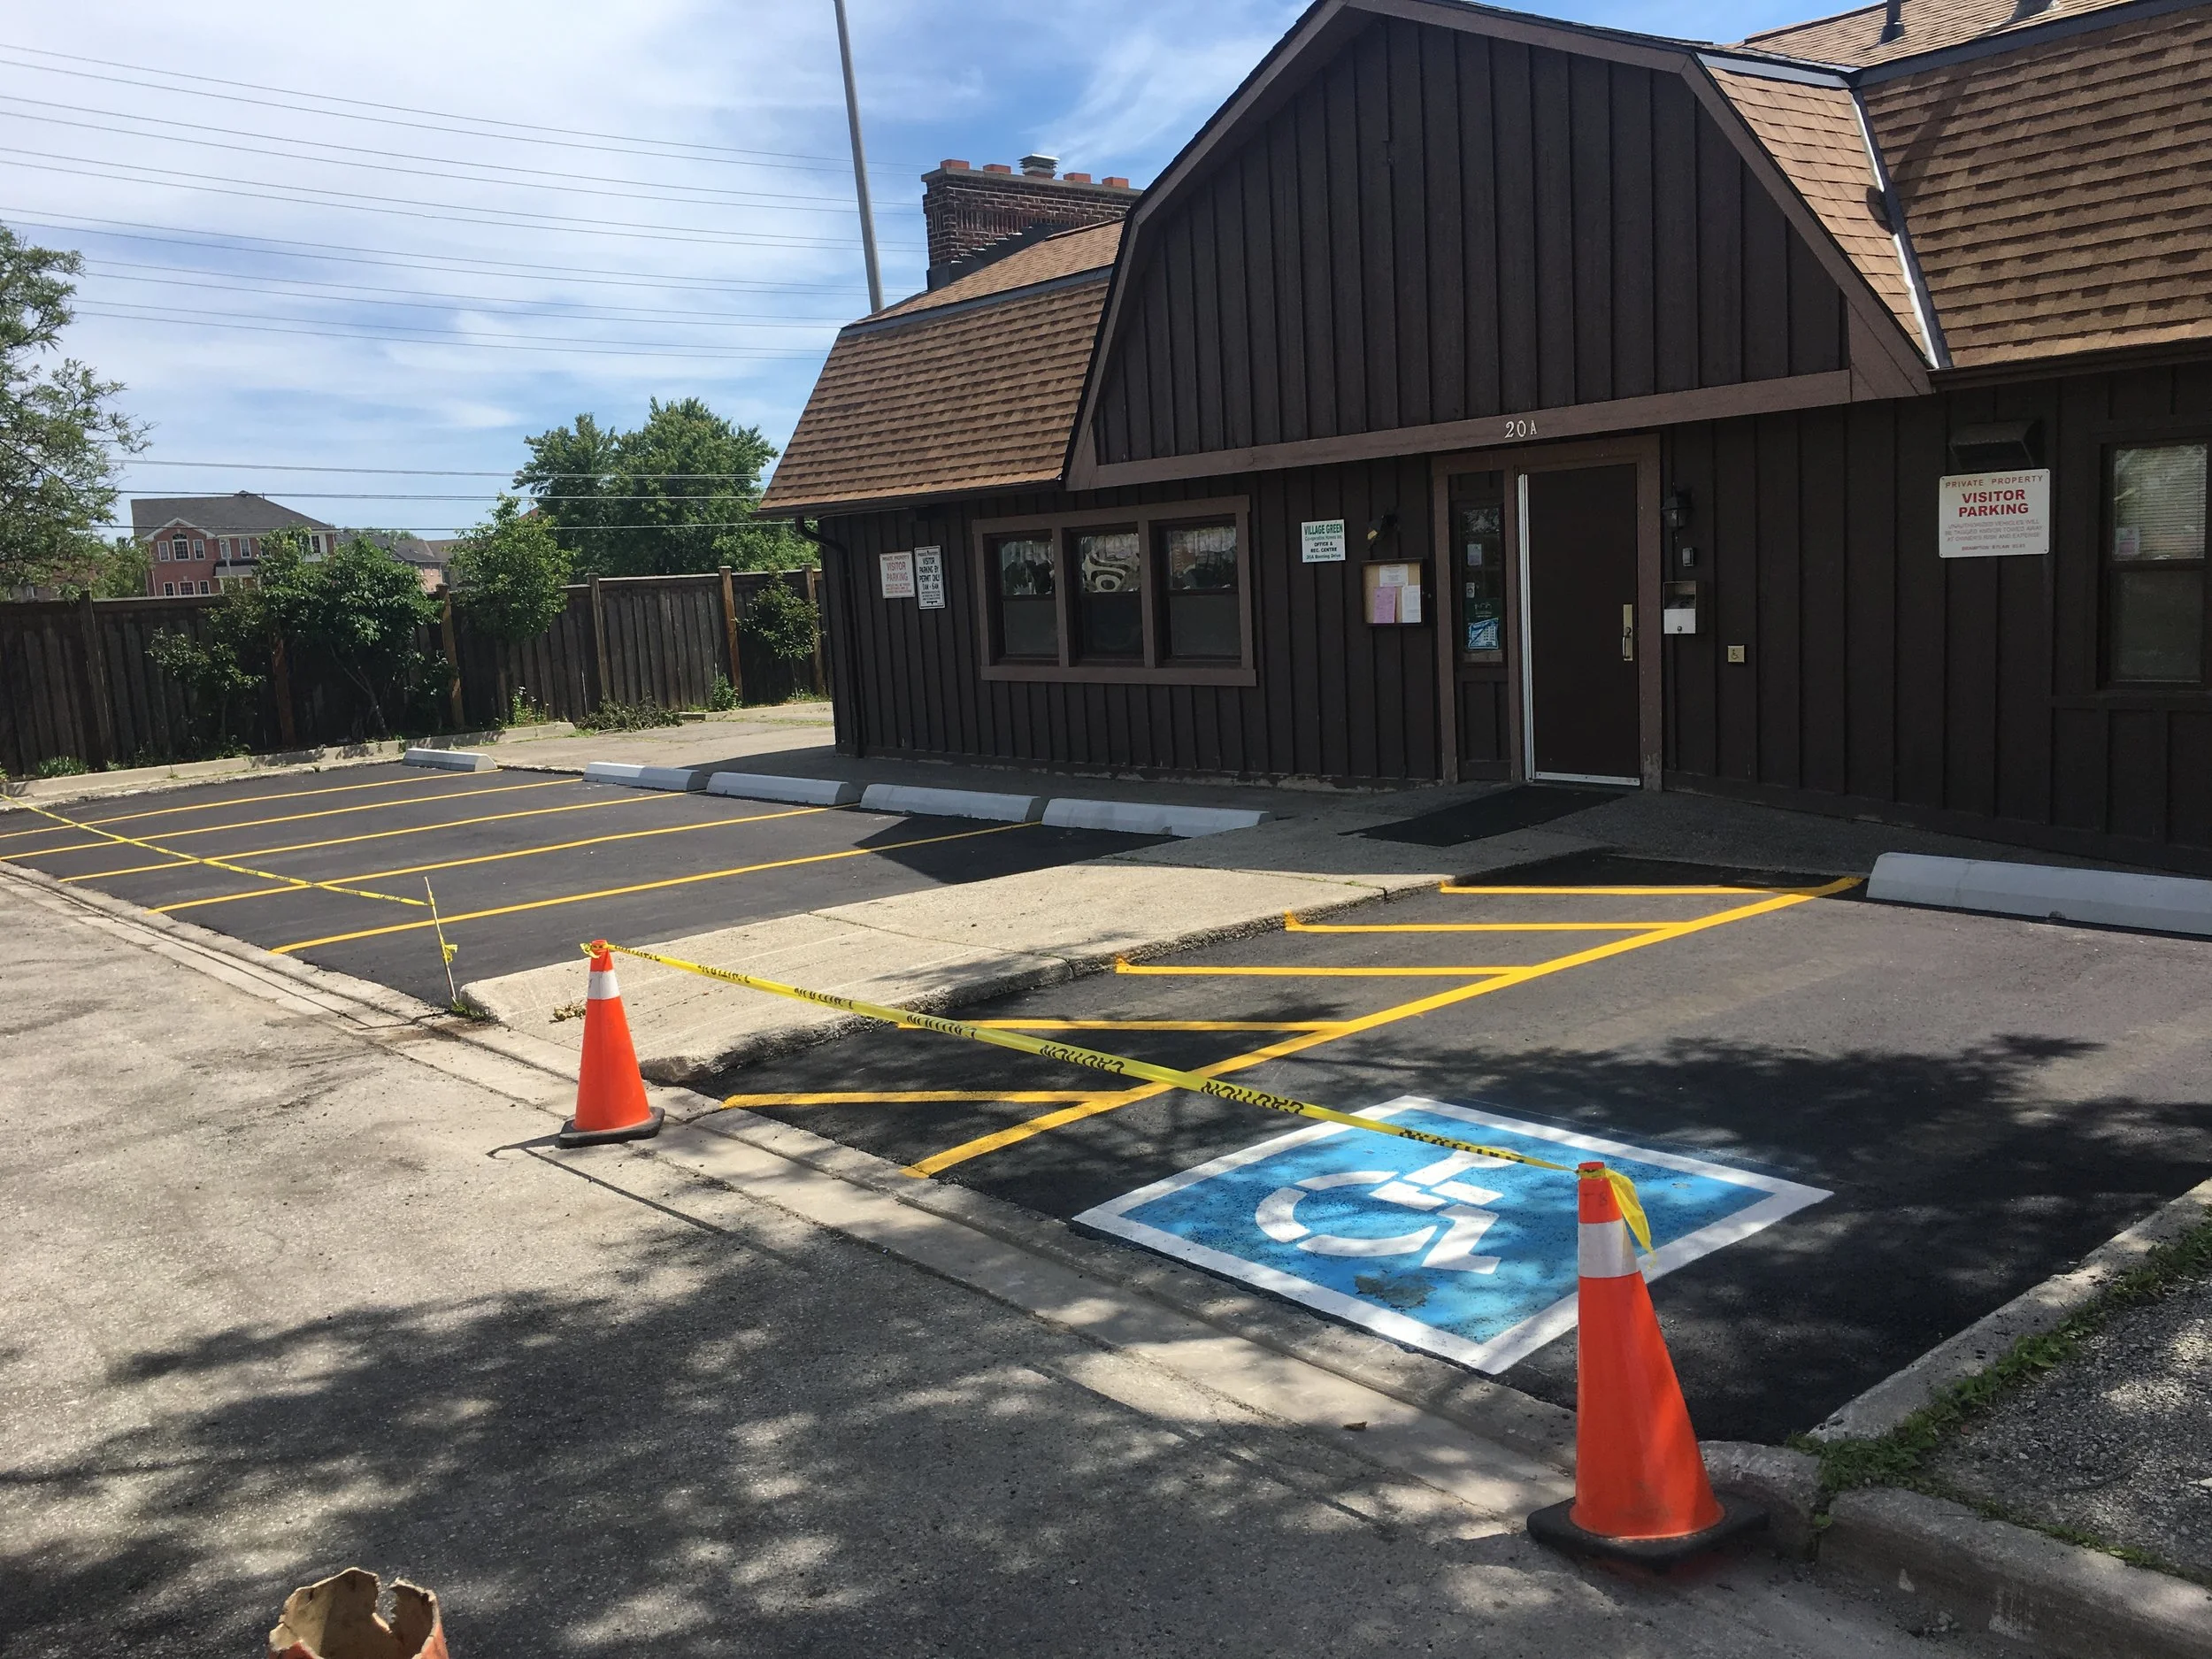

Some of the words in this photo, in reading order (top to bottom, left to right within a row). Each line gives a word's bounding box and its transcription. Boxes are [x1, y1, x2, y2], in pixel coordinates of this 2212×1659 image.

[1504, 419, 1538, 439] 20A
[1946, 479, 1985, 488] PRIVATE
[1992, 474, 2044, 485] PROPERTY
[1962, 489, 2025, 503] VISITOR
[1959, 503, 2028, 517] PARKING
[1303, 525, 1325, 534] VILLAGE
[1326, 524, 1342, 534] GREEN
[887, 562, 905, 571] VISITOR
[887, 572, 908, 581] PARKING
